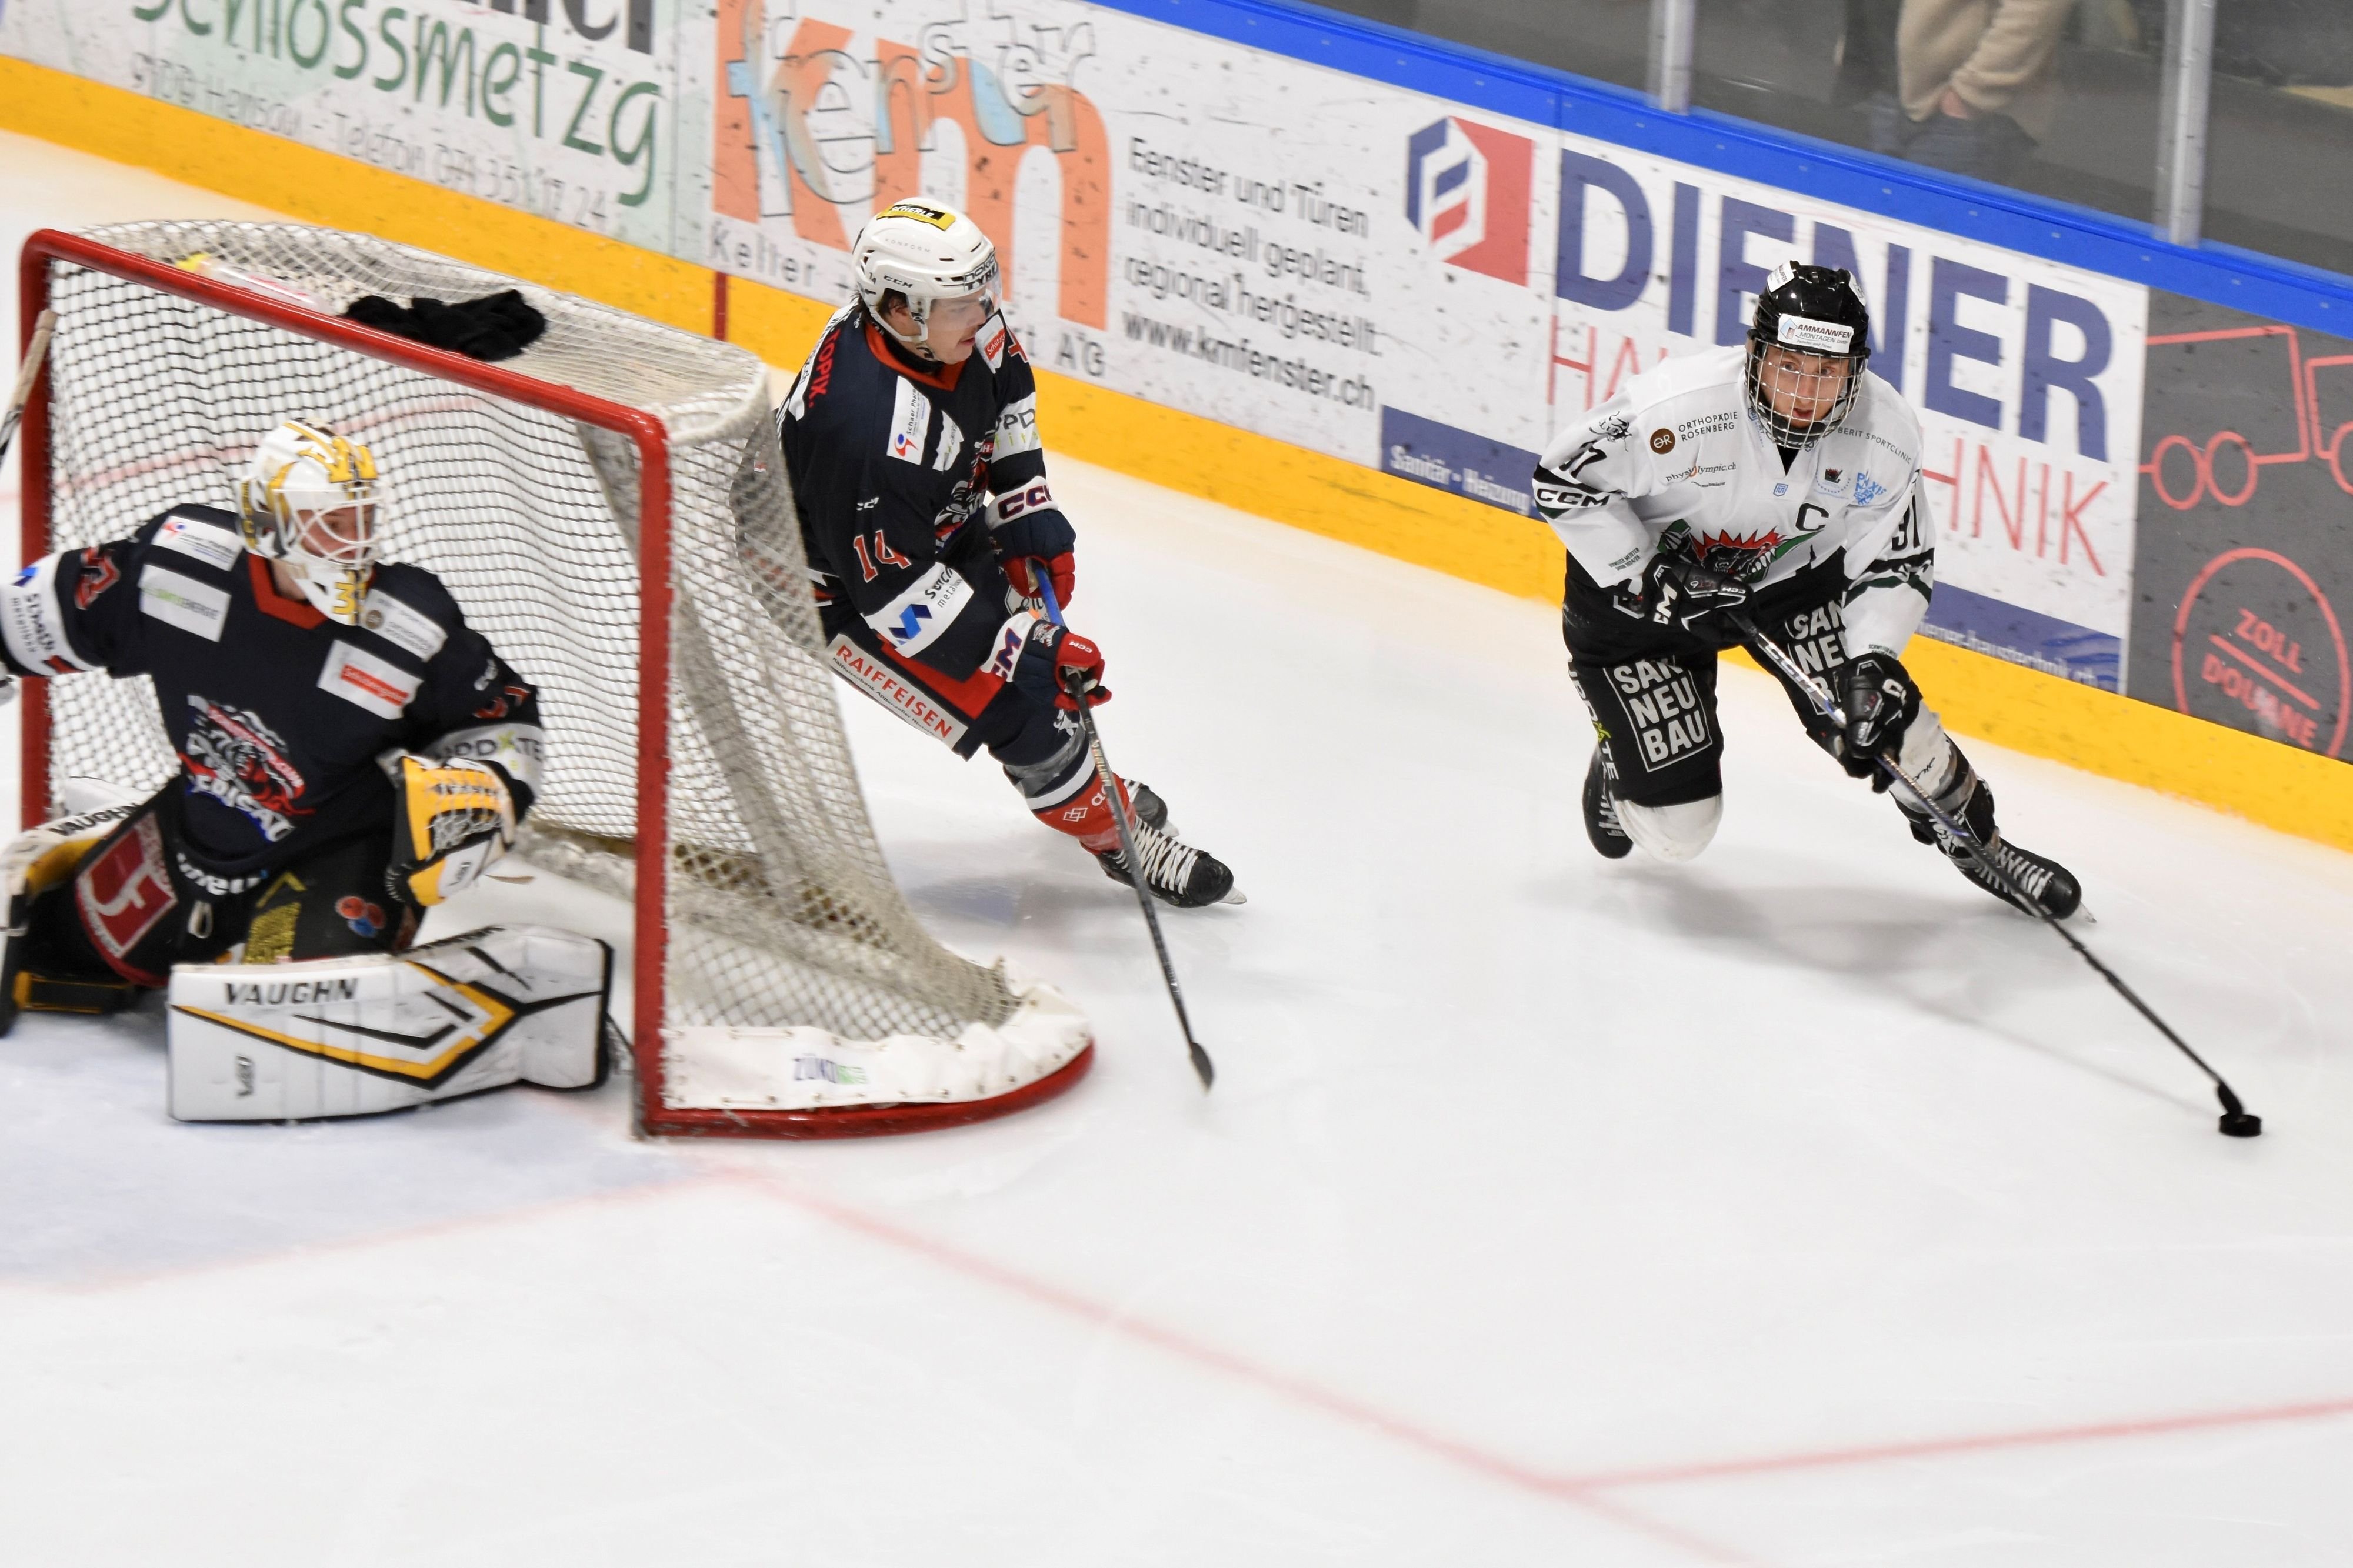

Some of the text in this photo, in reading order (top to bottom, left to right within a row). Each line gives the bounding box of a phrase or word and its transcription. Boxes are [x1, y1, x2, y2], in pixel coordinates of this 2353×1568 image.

[1129, 136, 1369, 238] Fenster und Türen
[708, 219, 818, 288] Keller
[884, 238, 931, 253] KONFORM
[1126, 192, 1259, 262] individuell
[884, 275, 913, 289] CCM
[1124, 256, 1231, 311] regional
[1556, 148, 2112, 463] DIENER
[1055, 331, 1106, 380] AG
[1122, 310, 1375, 411] www.kmfenster.ch
[1799, 332, 1837, 343] MONTAGEN
[1678, 411, 1738, 433] ORTHOPÄDIE
[1681, 422, 1735, 442] ROSENBERG
[1838, 426, 1912, 465] BERIT SPORTCLINIC
[1389, 445, 1453, 485] Sanitär
[1462, 468, 1531, 517] Heizung
[1537, 488, 1611, 508] CCM
[1795, 503, 1829, 532] C
[853, 529, 912, 583] 14
[1069, 640, 1093, 654] CCM
[2235, 608, 2305, 675] ZOLL
[832, 656, 875, 692] Raiffeisenbank
[875, 690, 911, 719] Appenzeller
[836, 645, 953, 739] RAIFFEISEN
[1628, 676, 1696, 729] NEU
[2202, 653, 2319, 749] DOUANE
[1642, 710, 1706, 763] BAU
[48, 802, 142, 837] VAUGHN
[224, 978, 358, 1006] VAUGHN
